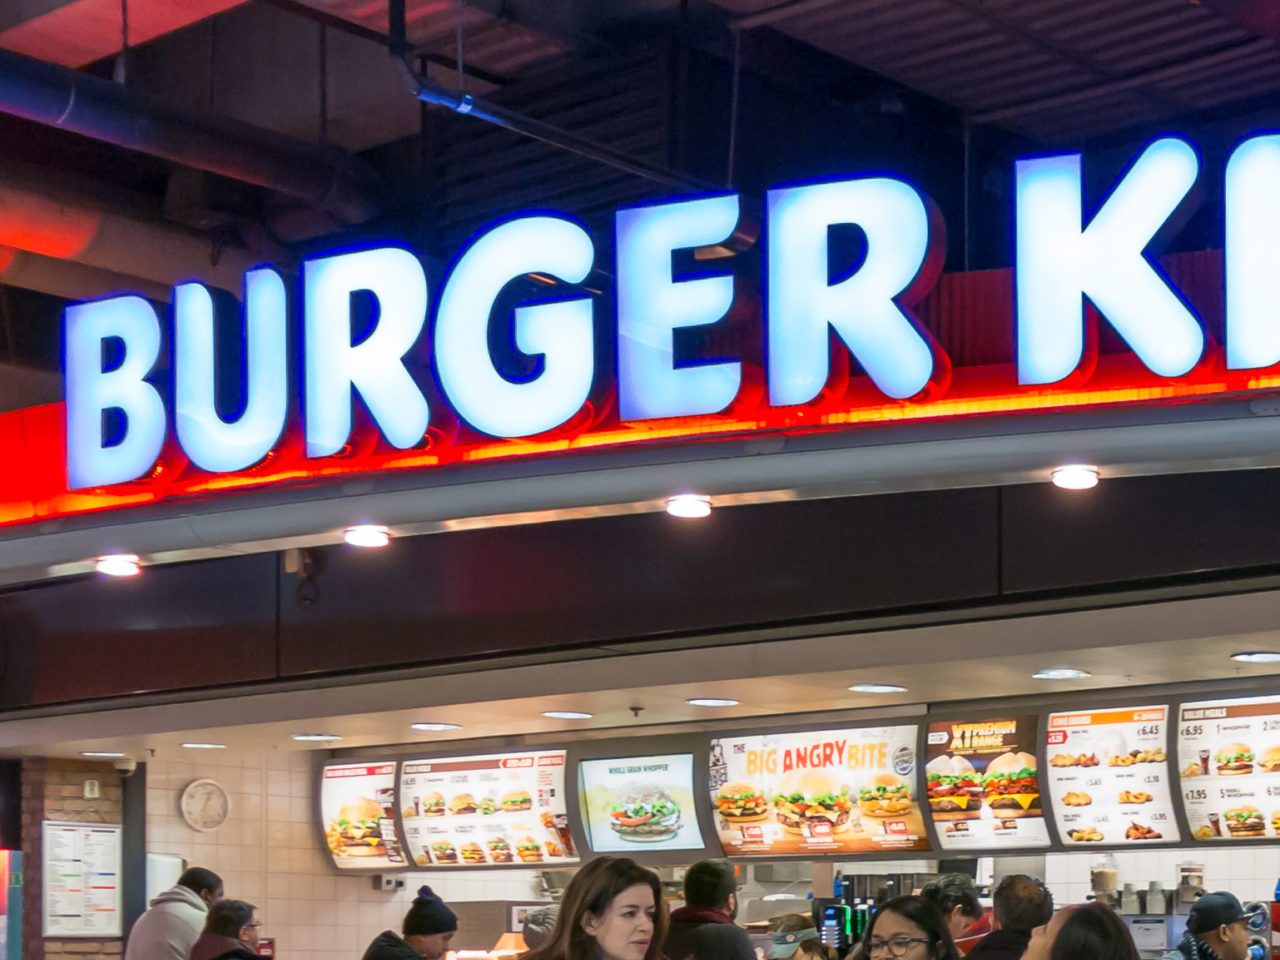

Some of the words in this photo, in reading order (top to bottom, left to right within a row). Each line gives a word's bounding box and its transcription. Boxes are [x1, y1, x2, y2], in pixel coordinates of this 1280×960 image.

[64, 175, 936, 492] BURGER
[1181, 725, 1203, 737] €6.95
[746, 749, 778, 776] BIG
[783, 739, 847, 774] ANGRY
[847, 742, 889, 770] BITE
